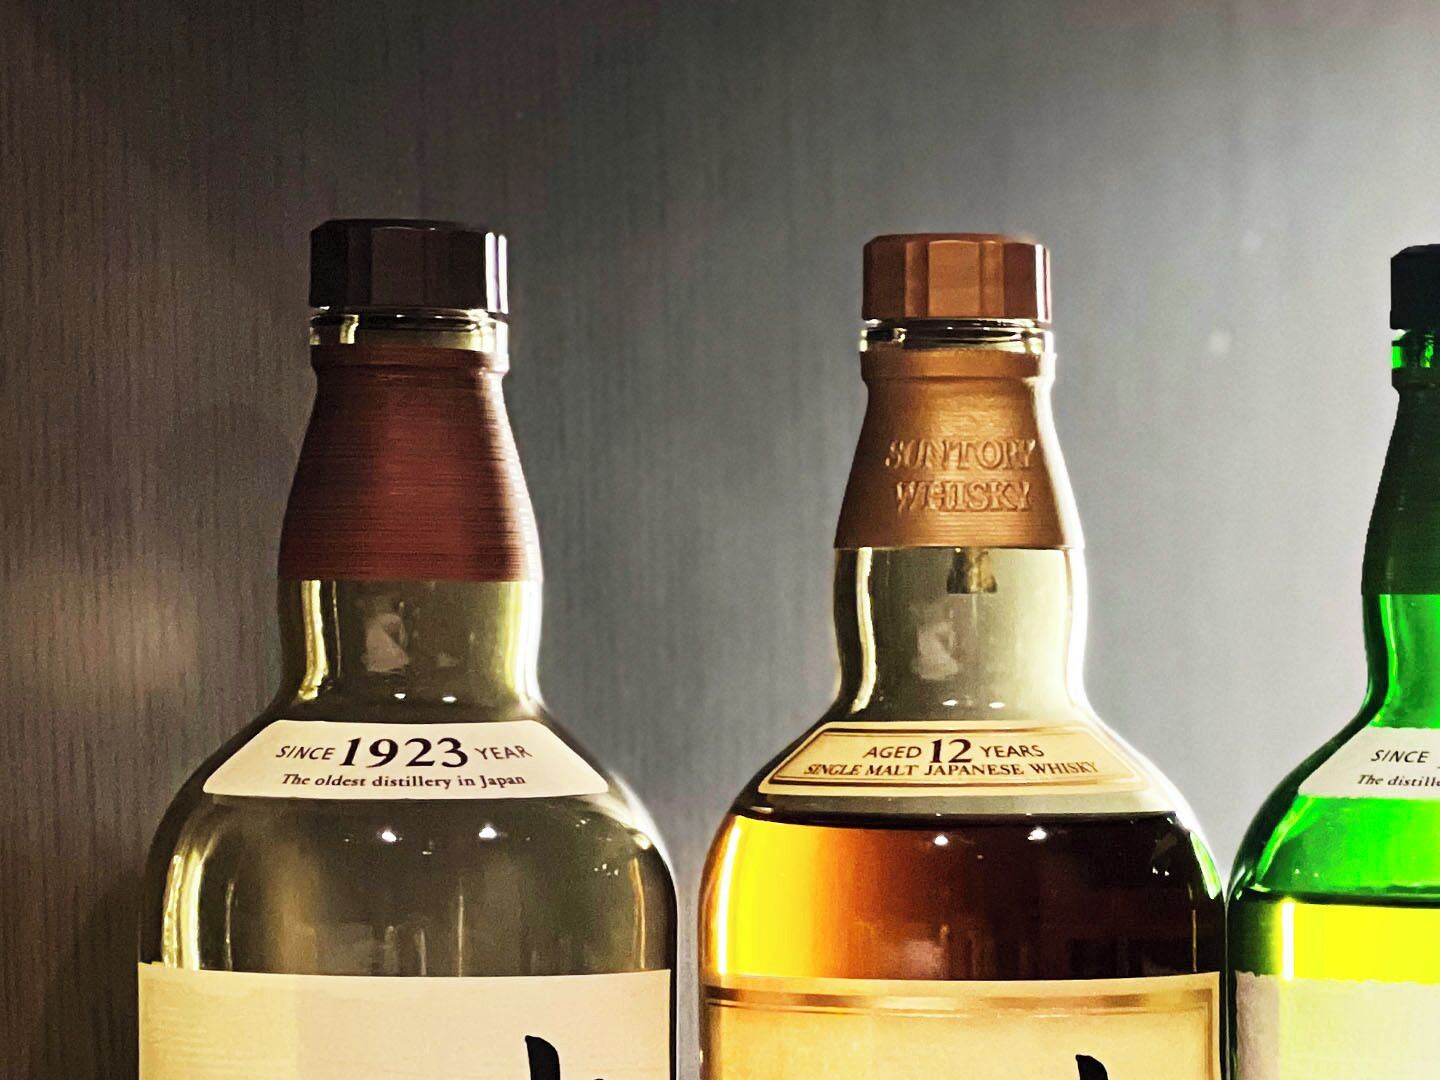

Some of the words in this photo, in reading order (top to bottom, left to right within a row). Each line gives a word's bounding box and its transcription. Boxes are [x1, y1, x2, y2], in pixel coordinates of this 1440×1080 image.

[885, 438, 1036, 470] SUNTORY
[896, 480, 1032, 512] WHISKY
[275, 745, 335, 761] SINCE
[339, 736, 468, 769] 1923
[474, 745, 533, 761] YEAR
[863, 745, 922, 760] AGED
[930, 738, 972, 764] 12
[980, 744, 1045, 758] YEARS
[1370, 749, 1429, 764] SINCE
[804, 763, 860, 776] SINGLE
[865, 763, 919, 776] MALT
[924, 763, 1025, 776] JAPANESE
[1030, 761, 1099, 775] WHISKY
[281, 773, 311, 788] The
[314, 774, 367, 788] oldest
[372, 774, 452, 790] distillery
[457, 774, 477, 788] in
[481, 773, 526, 789] Japan
[1356, 774, 1384, 787] The
